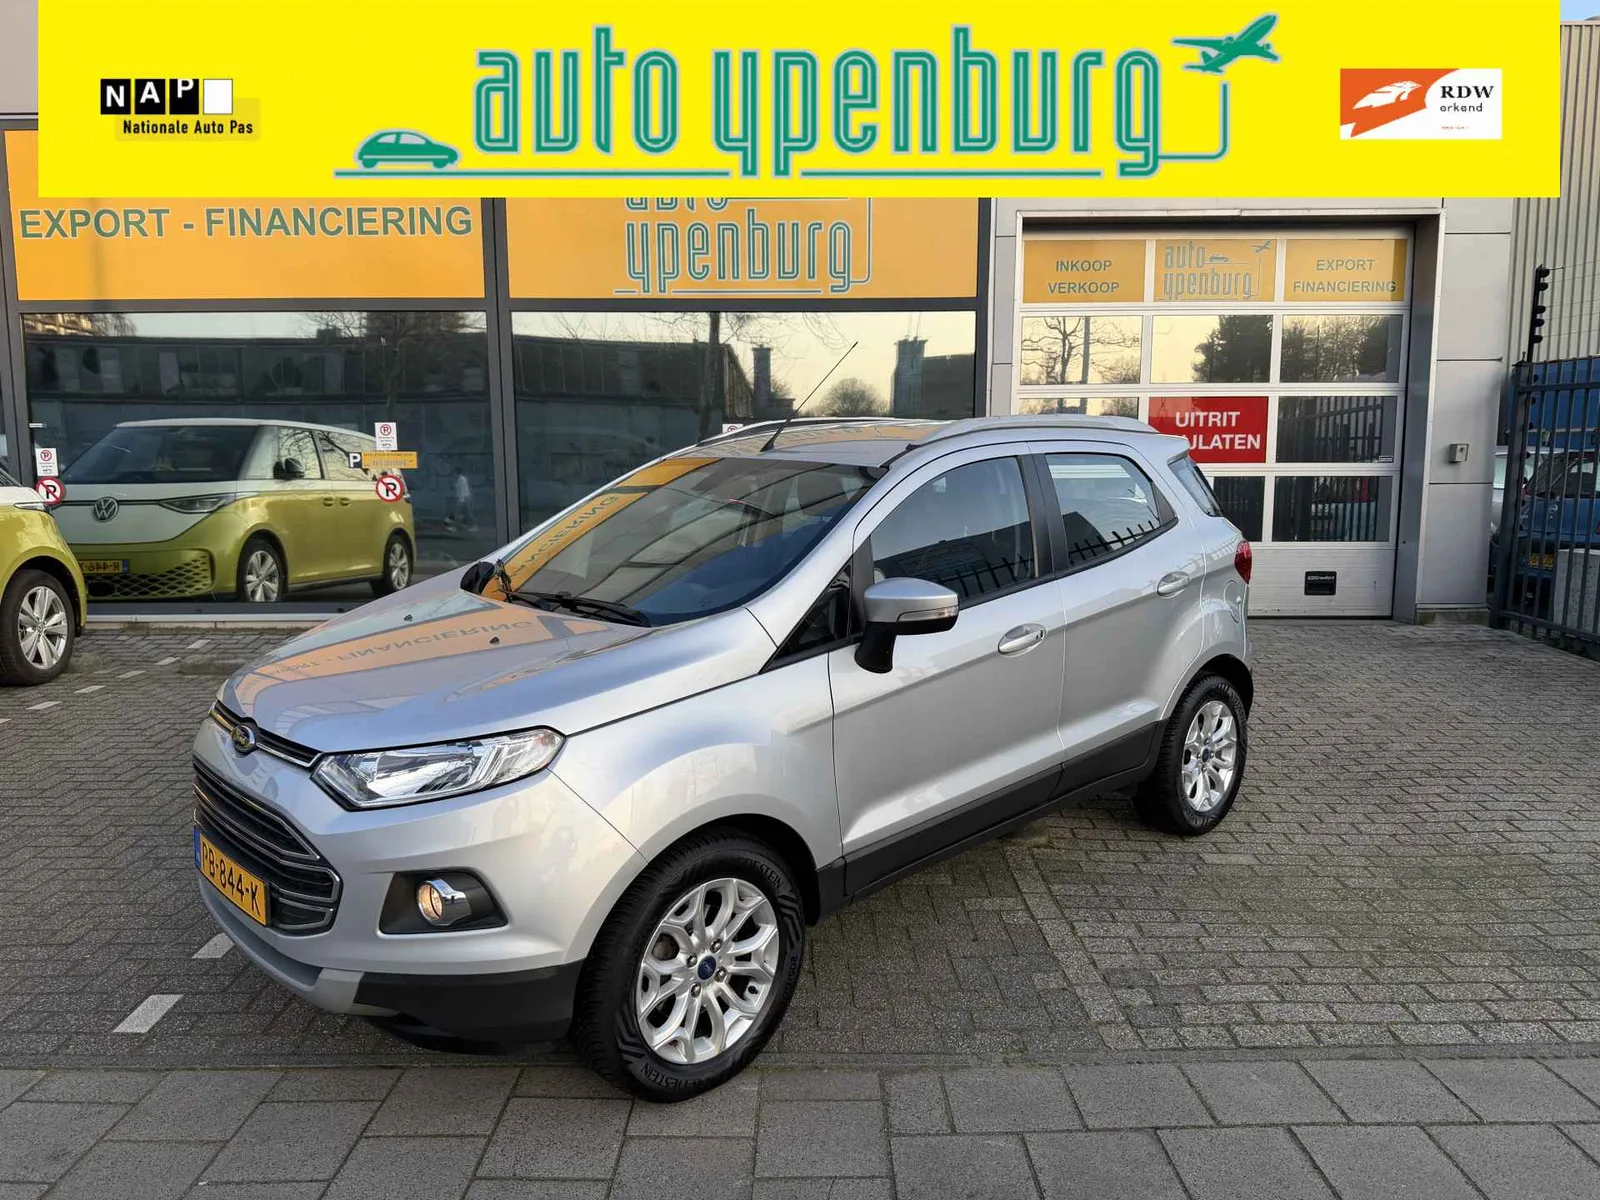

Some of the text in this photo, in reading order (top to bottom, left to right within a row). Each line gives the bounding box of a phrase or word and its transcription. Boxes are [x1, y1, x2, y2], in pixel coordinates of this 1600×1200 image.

[19, 208, 170, 239] EXPORT
[205, 206, 473, 238] FINANCIERING
[625, 208, 852, 294] ypenburg
[1164, 241, 1206, 269] auto
[1055, 260, 1113, 272] INKOOP
[1316, 259, 1376, 271] EXPORT
[1048, 282, 1120, 294] VERKOOP
[1163, 268, 1253, 300] ypenburg
[1292, 280, 1397, 292] FINANCIERING
[1175, 411, 1240, 428] UITRIT
[1182, 434, 1260, 450] JLATEN
[349, 453, 361, 467] P
[201, 839, 262, 916] PB-844-K
